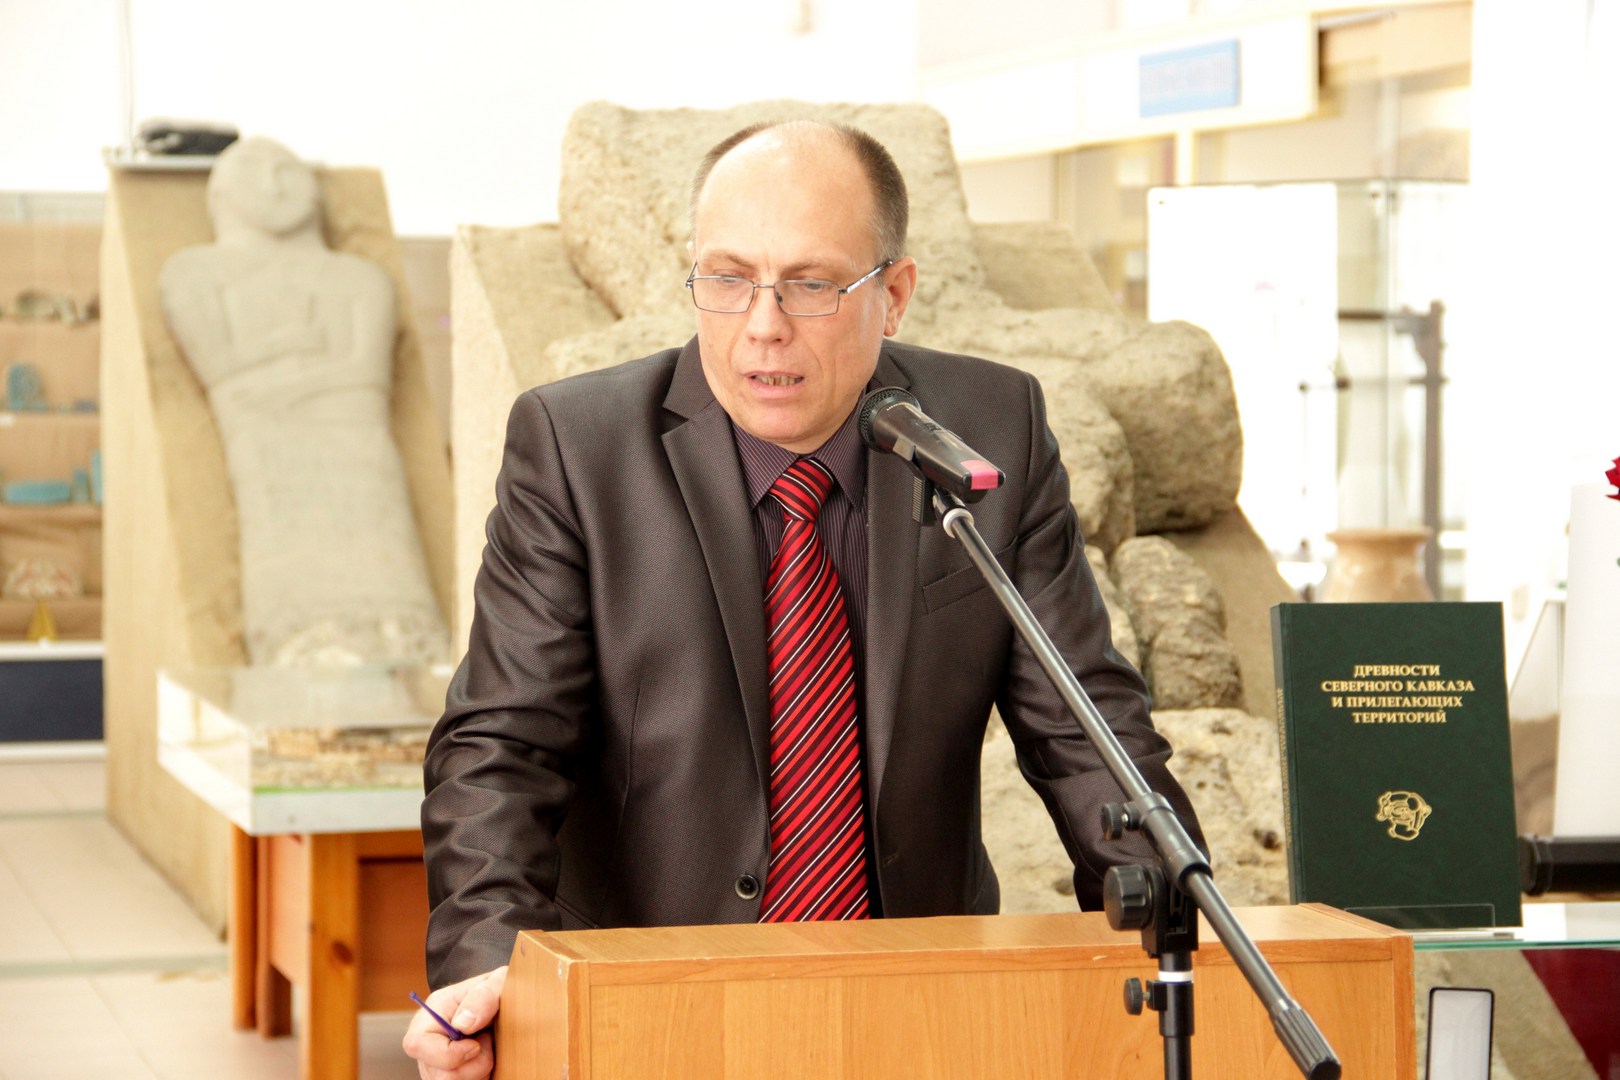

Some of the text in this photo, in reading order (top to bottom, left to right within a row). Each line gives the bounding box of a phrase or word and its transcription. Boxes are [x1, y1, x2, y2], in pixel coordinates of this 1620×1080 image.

[1353, 664, 1441, 679] ДРЕВНОСТИ
[1320, 680, 1475, 692] СЕВЕРНОГО КАВКАЗА
[1331, 695, 1463, 709] И ПРИЛЕГАЮЩИХ
[1352, 709, 1447, 724] ТЕРРИТОРИЙ
